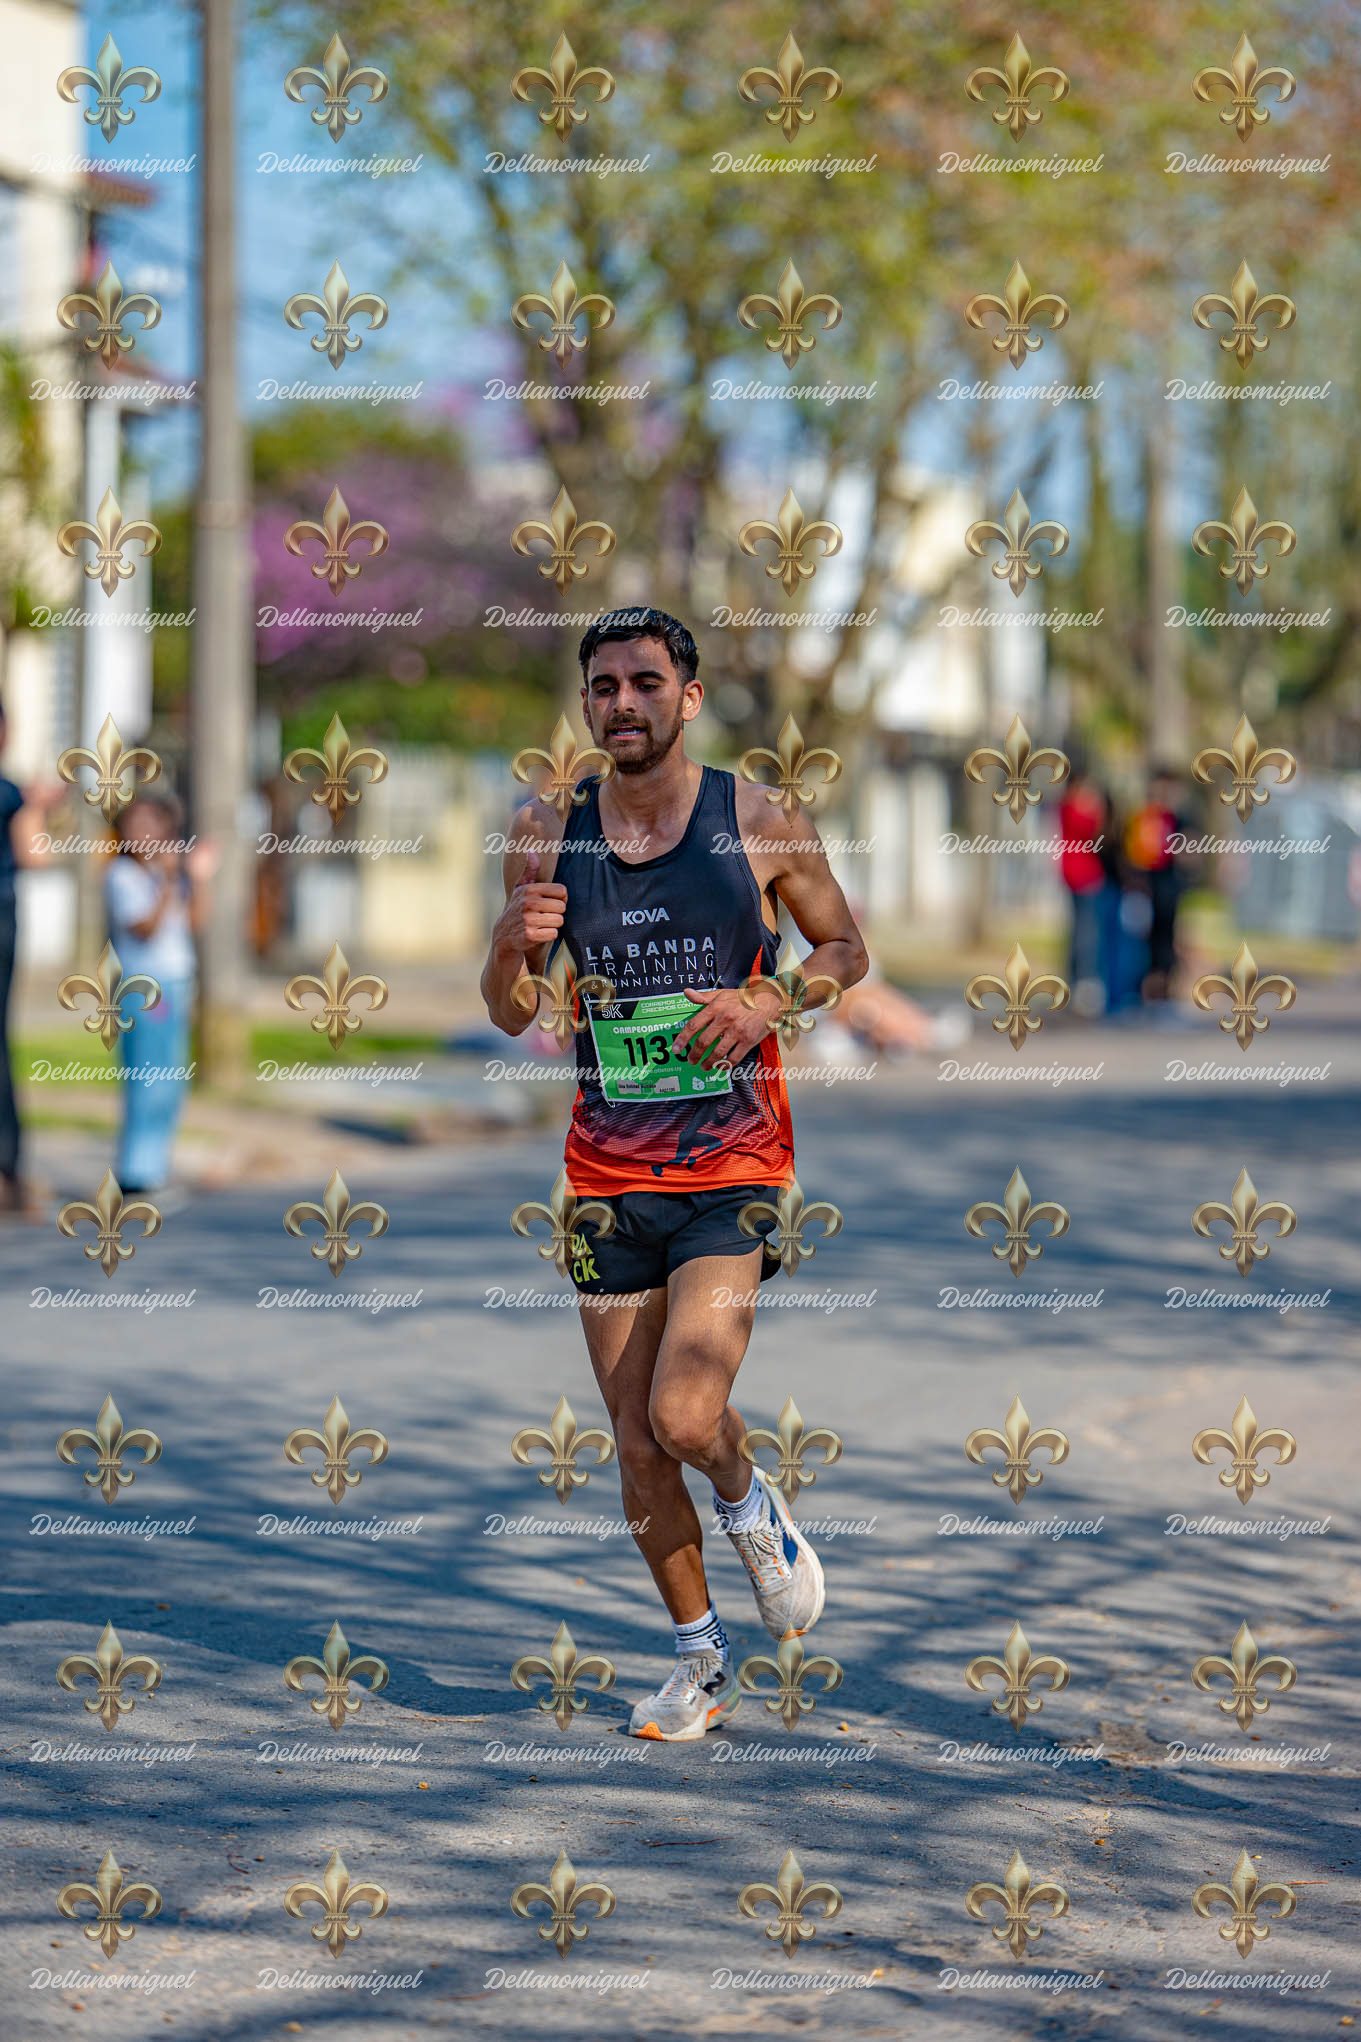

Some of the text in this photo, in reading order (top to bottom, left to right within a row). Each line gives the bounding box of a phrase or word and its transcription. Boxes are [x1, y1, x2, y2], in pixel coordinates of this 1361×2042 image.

[622, 907, 670, 926] KOVA
[585, 936, 715, 961] LA BANDA
[589, 953, 715, 977] TRAINING
[602, 975, 673, 988] RUNNING
[601, 1003, 624, 1019] 5K
[612, 1022, 672, 1034] CAMPEONATO
